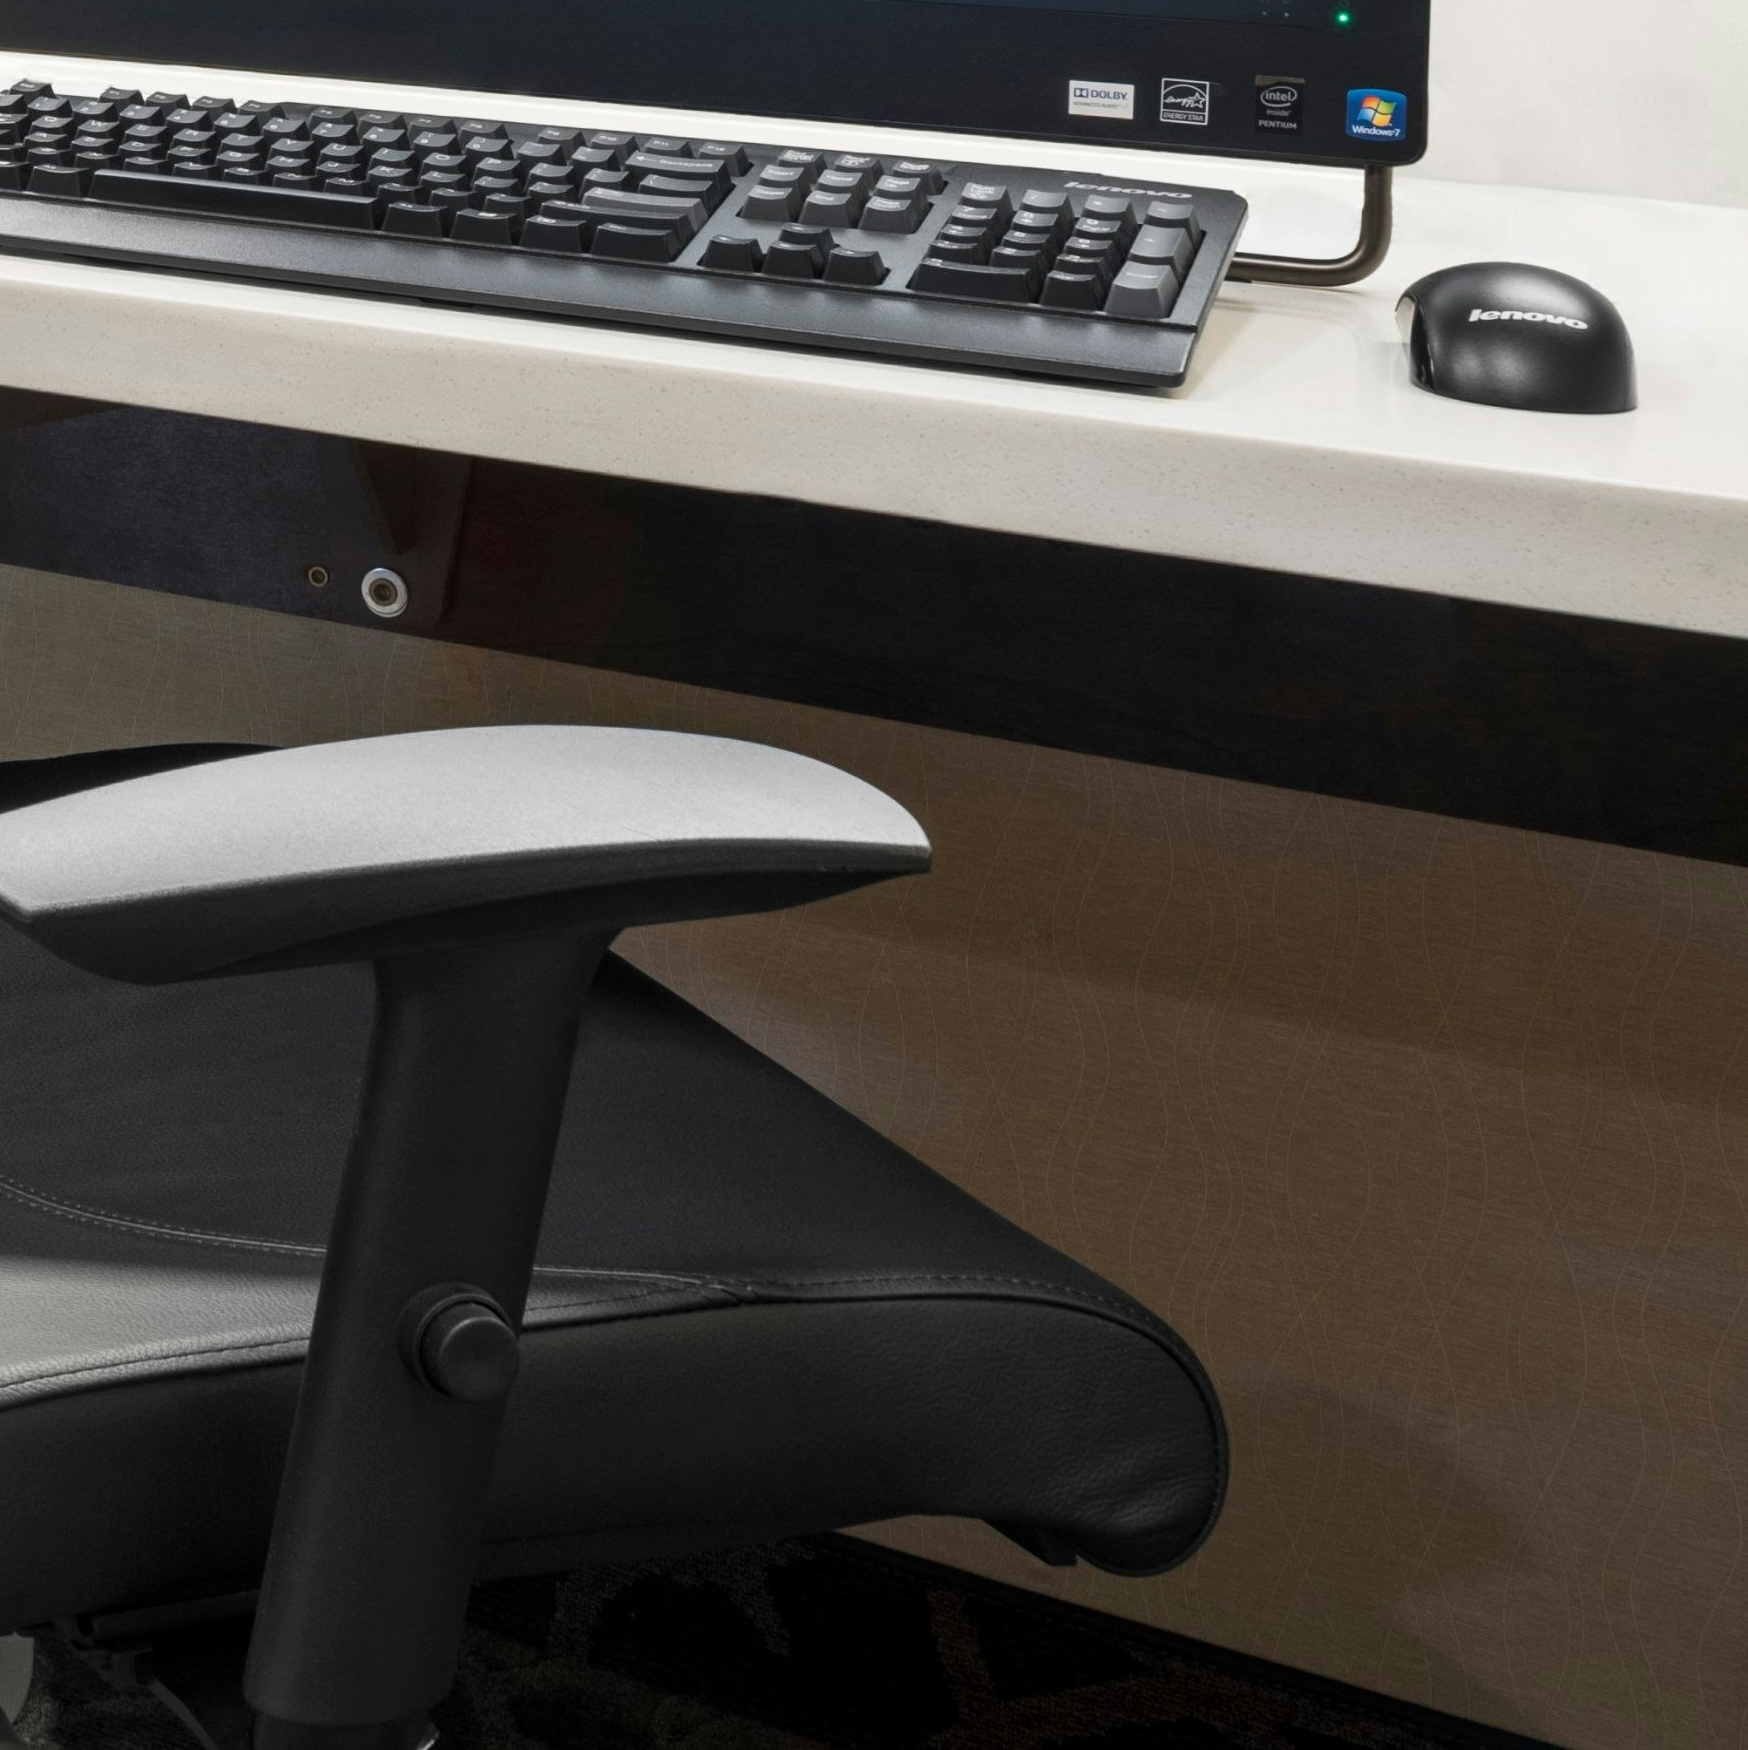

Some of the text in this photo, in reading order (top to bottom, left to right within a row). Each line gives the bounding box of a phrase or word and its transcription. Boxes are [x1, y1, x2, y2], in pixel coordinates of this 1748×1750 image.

[1091, 90, 1128, 100] DOLBY
[1265, 91, 1291, 101] intel
[1163, 112, 1186, 120] ENERGY
[1259, 120, 1297, 129] PENTIUM
[1352, 125, 1400, 137] Windows 7
[1064, 182, 1192, 199] lenovo
[1469, 309, 1588, 330] lenovo
